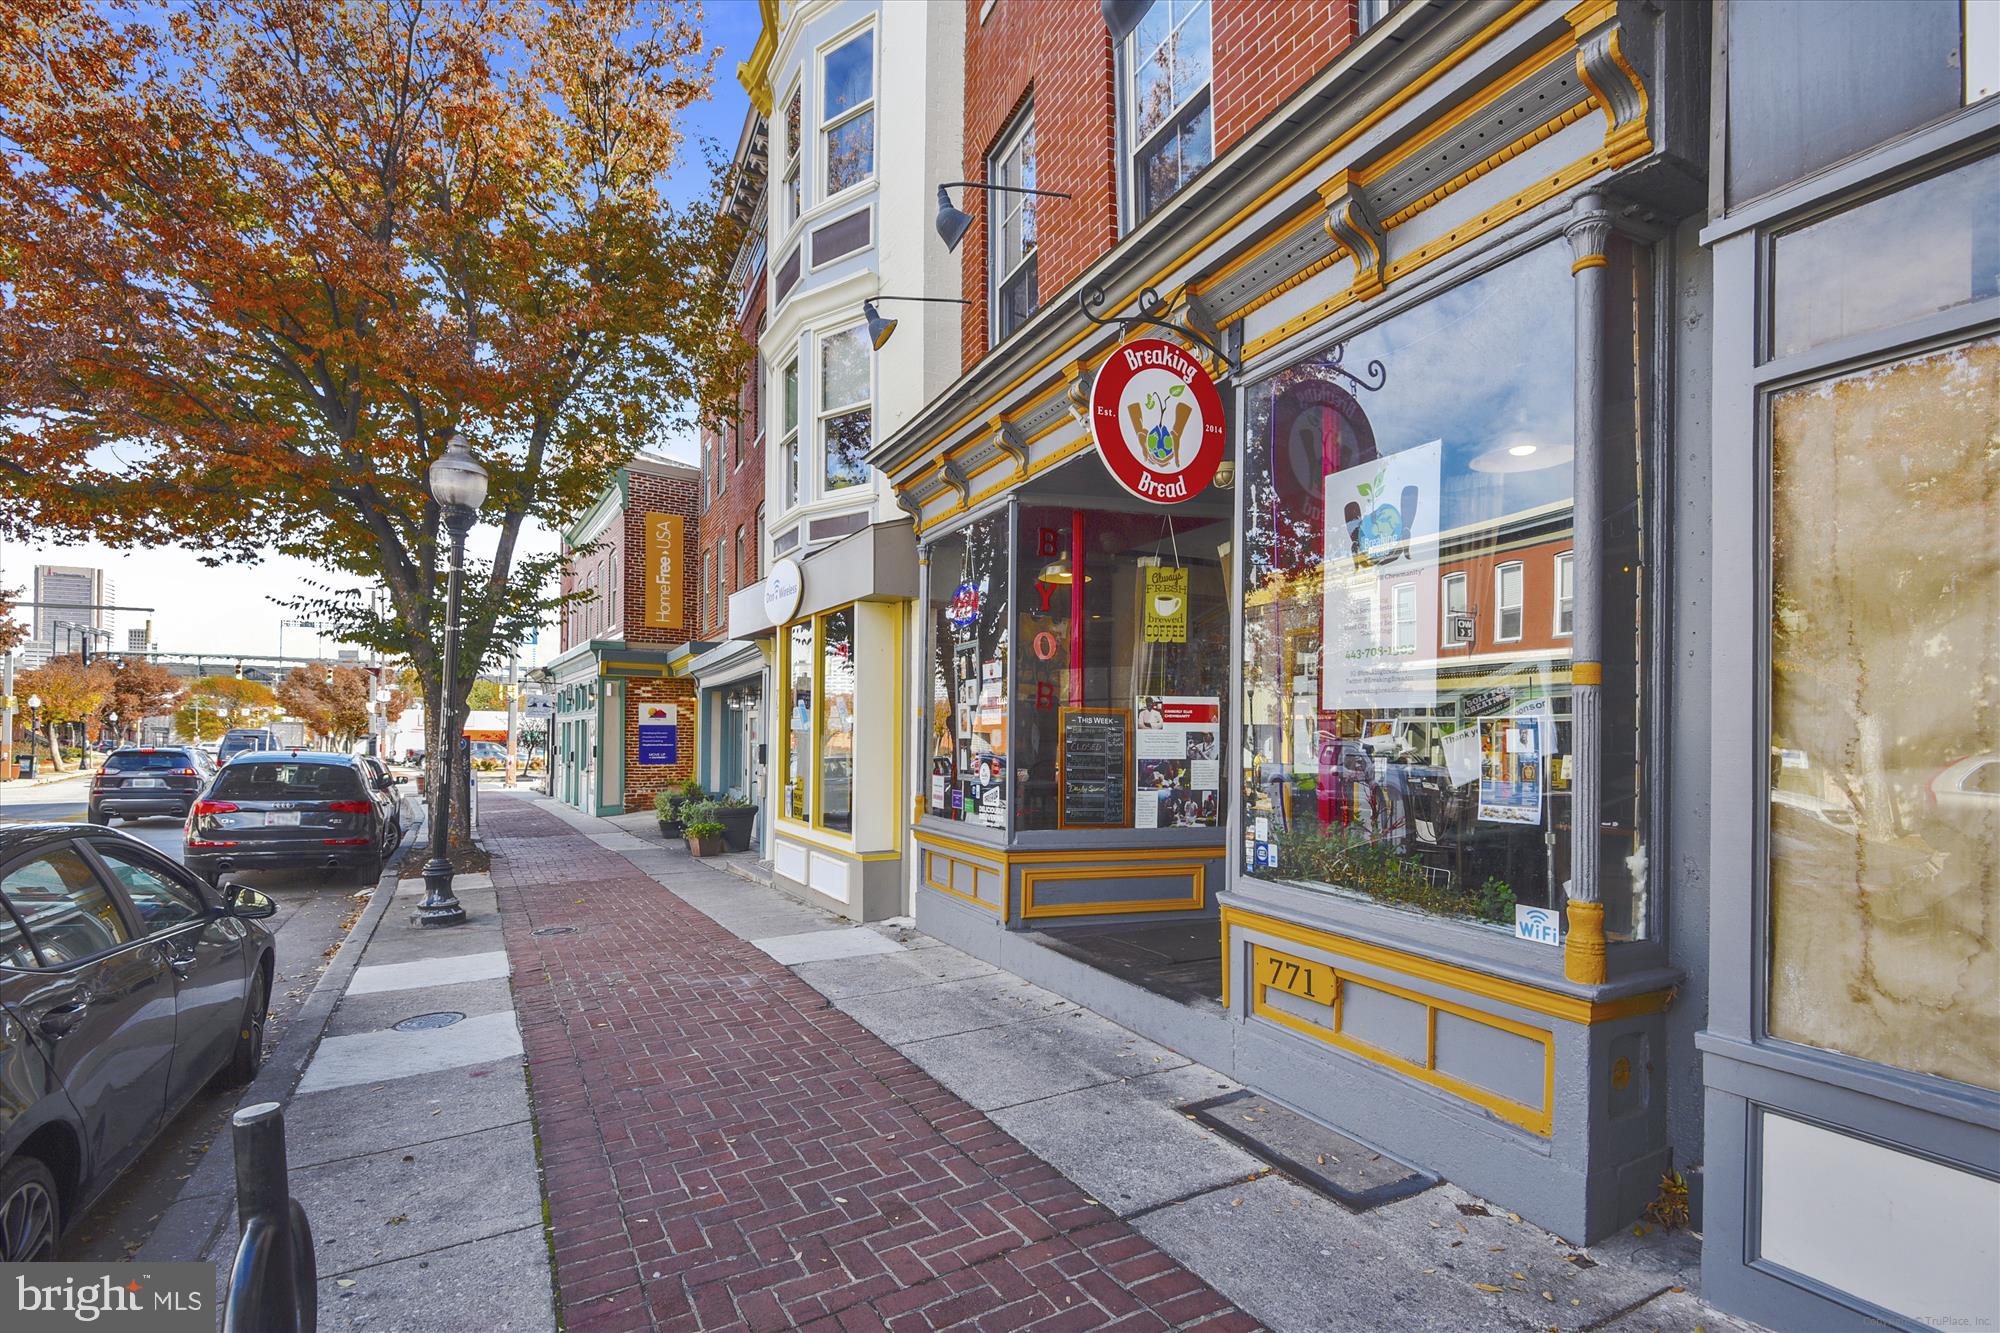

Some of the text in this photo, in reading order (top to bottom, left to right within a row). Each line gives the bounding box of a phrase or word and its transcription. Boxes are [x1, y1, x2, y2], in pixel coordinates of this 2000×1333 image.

[1123, 345, 1198, 385] Breaking
[1097, 406, 1116, 417] Est.
[1205, 424, 1223, 434] 2014
[1137, 470, 1188, 499] Bread
[1151, 571, 1184, 586] Always
[1146, 584, 1188, 595] FRESH
[1148, 612, 1183, 624] brewed
[1146, 624, 1185, 637] COFFEE
[1077, 716, 1114, 725] THIS WEEK
[1444, 729, 1469, 745] Thank
[1070, 742, 1102, 751] CLOSED
[1519, 921, 1557, 944] WiFi
[1270, 957, 1315, 998] 771
